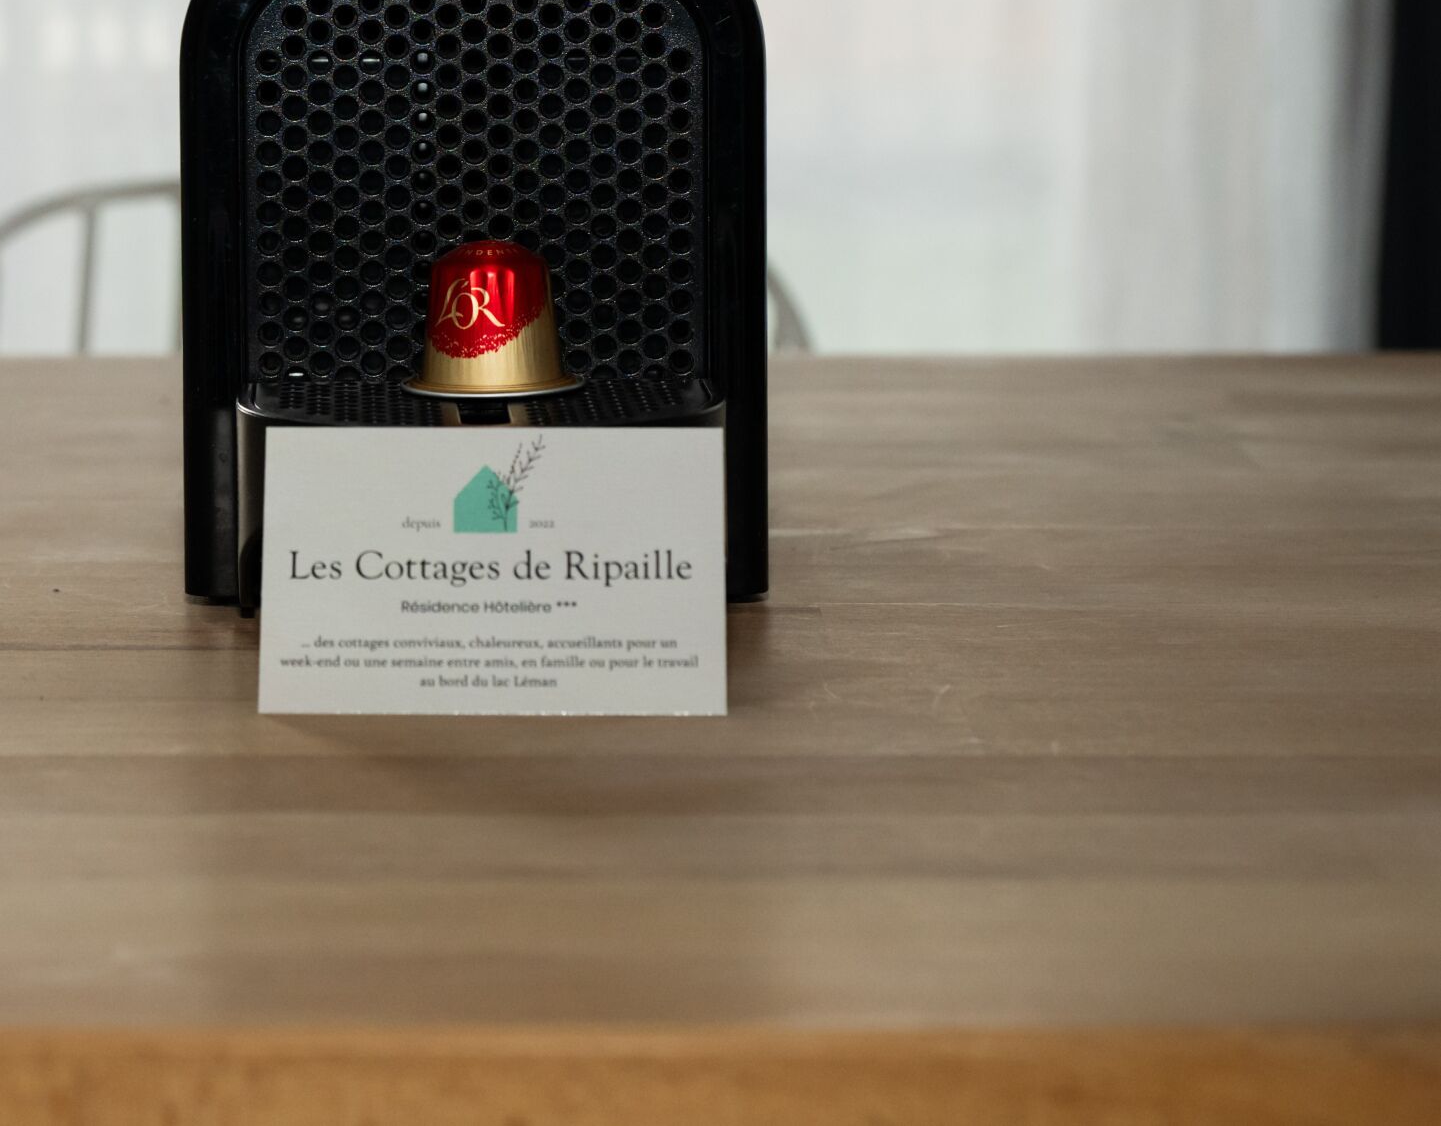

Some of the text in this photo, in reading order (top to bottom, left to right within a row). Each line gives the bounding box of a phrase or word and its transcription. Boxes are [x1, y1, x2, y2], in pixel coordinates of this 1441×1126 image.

[401, 516, 555, 532] depuis 2022
[289, 549, 693, 588] Les Cottages de Ripaille
[400, 600, 552, 614] Résidence Hôtelière
[314, 636, 334, 648] des
[338, 639, 389, 651] cottages
[393, 638, 466, 650] conviviaux,
[469, 637, 543, 649] chaleureux,
[547, 636, 623, 649] accueillants
[626, 639, 656, 652] pour
[660, 640, 677, 649] un
[280, 655, 699, 671] week-end ou une semaine entre amis, en famille ou pour le travail
[420, 675, 557, 688] au bord du lac Léman
